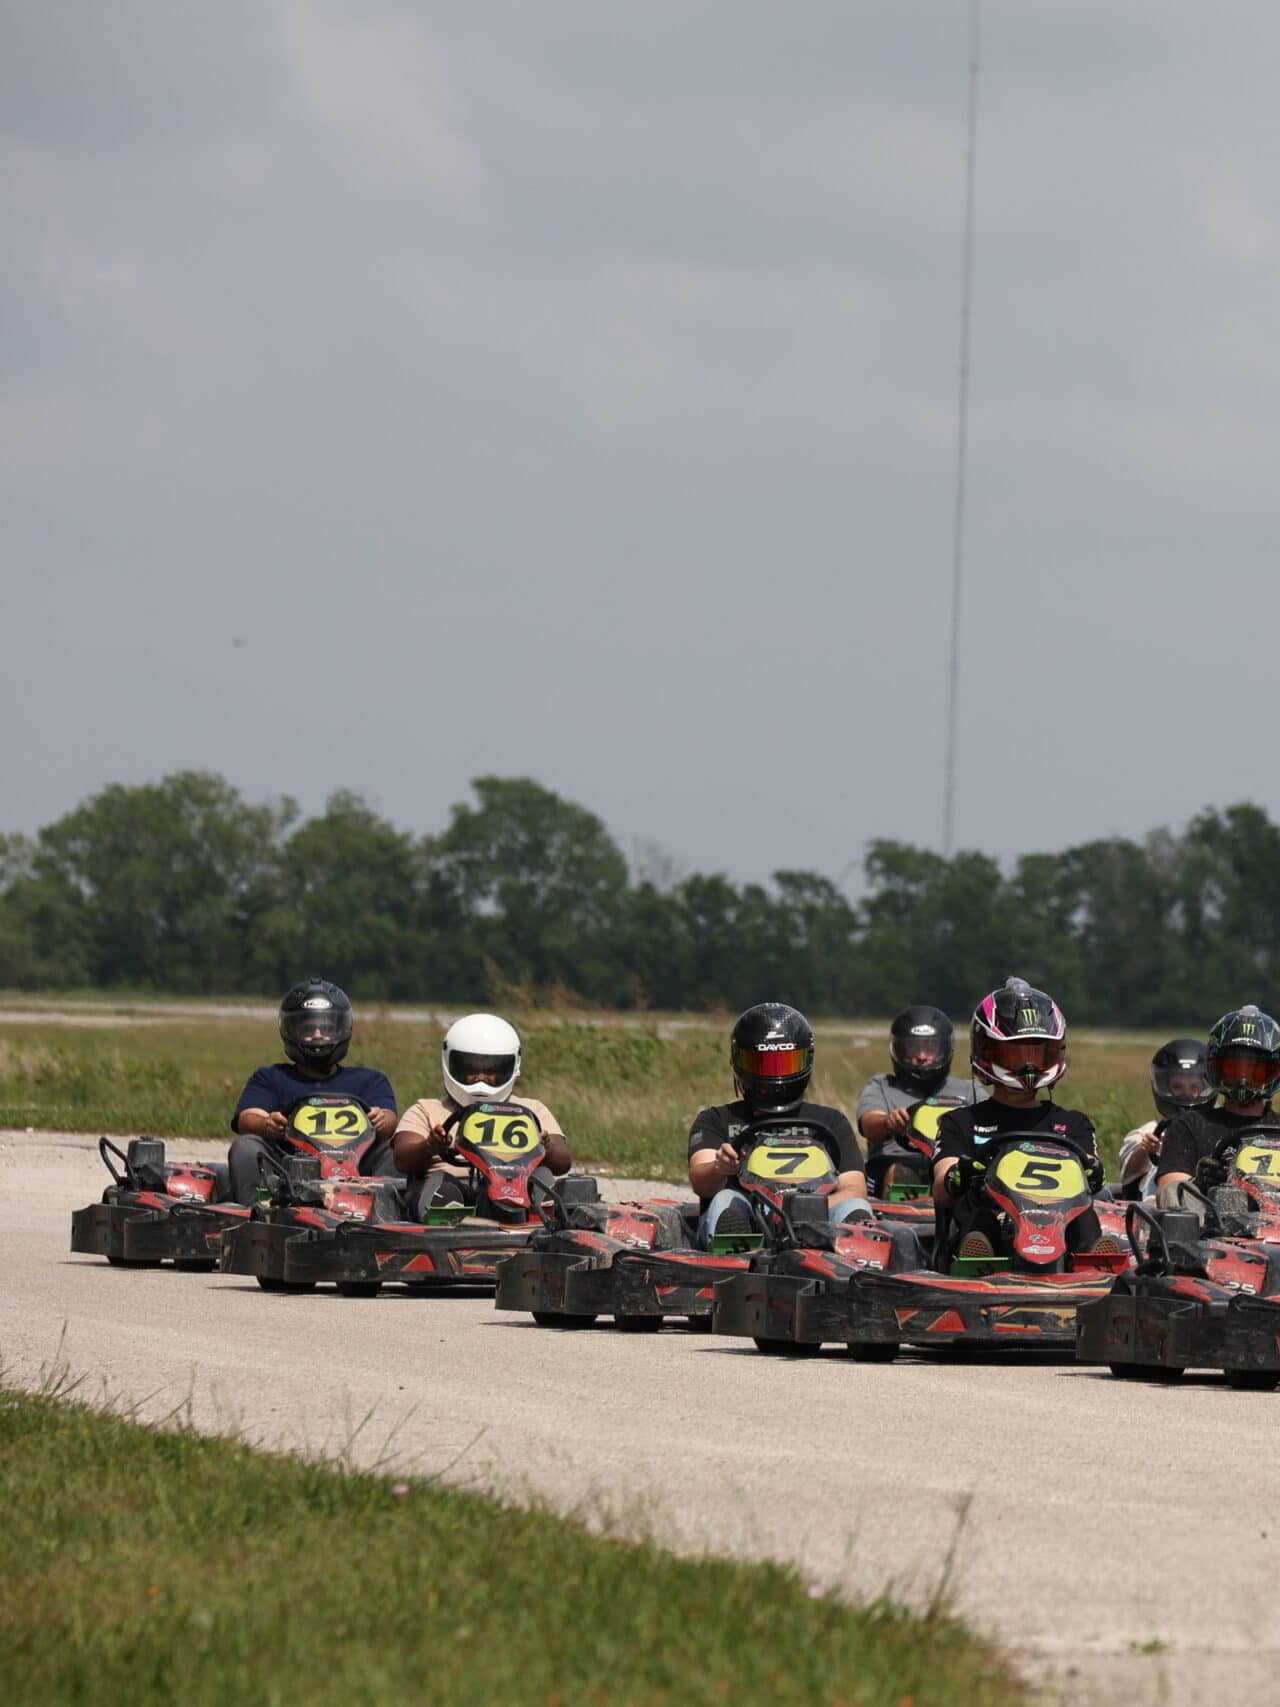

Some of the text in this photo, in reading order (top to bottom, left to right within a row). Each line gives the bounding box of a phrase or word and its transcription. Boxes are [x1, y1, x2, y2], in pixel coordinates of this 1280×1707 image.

[757, 1043, 796, 1051] DAYCO
[307, 1110, 360, 1136] 12
[474, 1118, 529, 1148] 16
[766, 1152, 810, 1175] 7
[1015, 1161, 1062, 1190] 5
